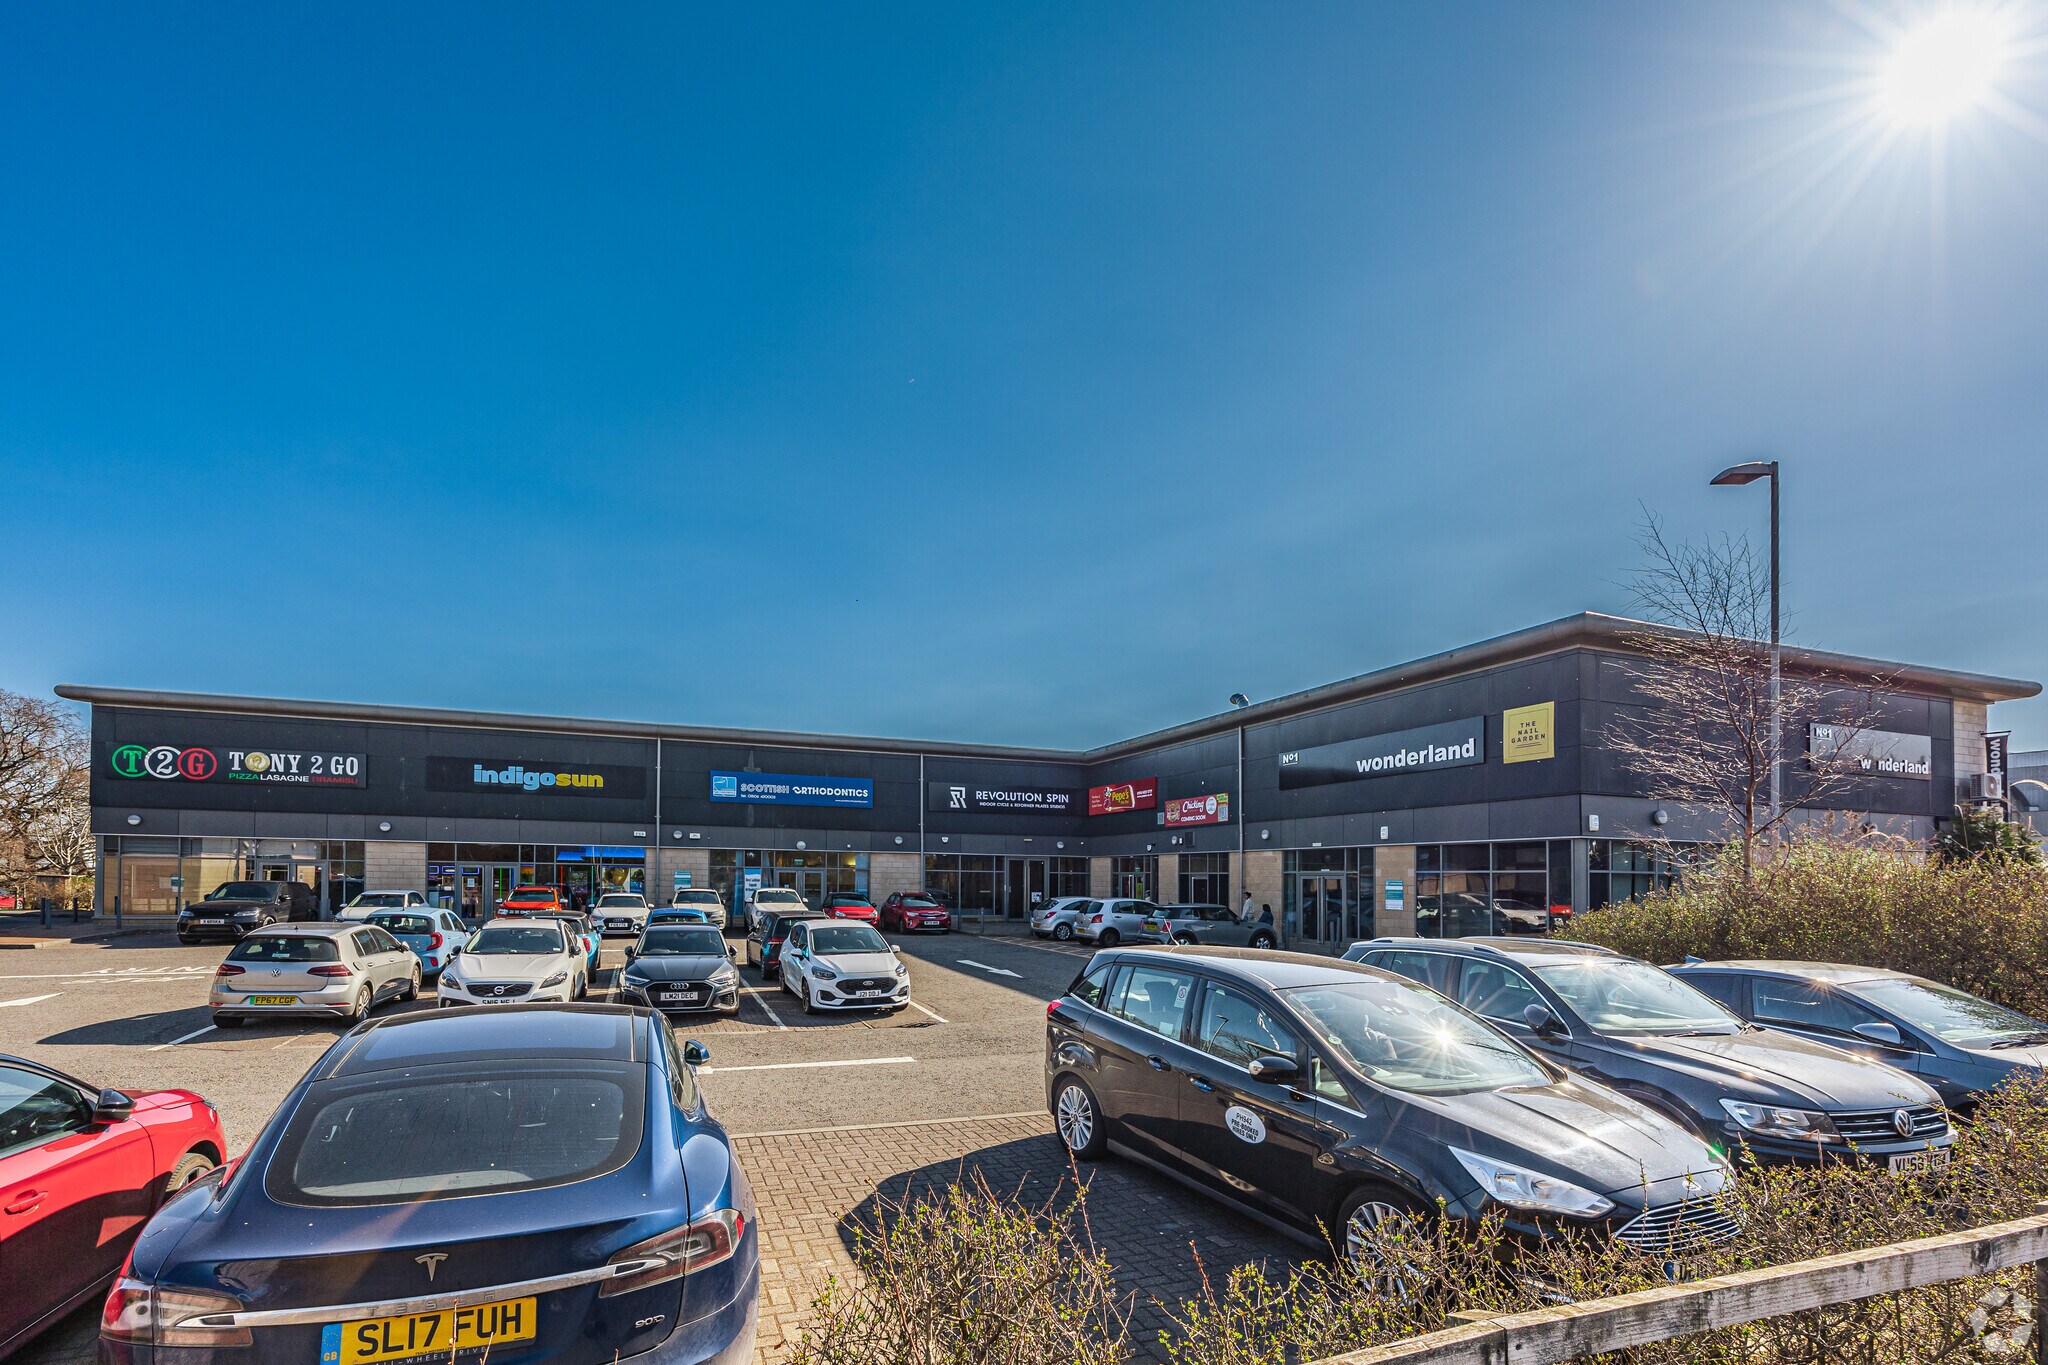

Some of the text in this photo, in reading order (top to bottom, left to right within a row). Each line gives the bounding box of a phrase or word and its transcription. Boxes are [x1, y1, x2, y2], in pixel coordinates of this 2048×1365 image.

[1520, 720, 1536, 728] THE
[1511, 733, 1546, 744] GARDEN
[1517, 728, 1539, 736] NAIL
[1356, 738, 1475, 773] wonderland
[310, 755, 324, 774] 2
[330, 756, 359, 776] GO
[1860, 758, 1929, 775] wnderland
[228, 772, 359, 784] PIZZA LASAGNE TIRAMISU
[474, 764, 603, 790] indigosun
[740, 783, 790, 794] SCOTTISH
[792, 786, 868, 798] ORTHODONTICS
[975, 790, 1042, 802] REVOLUTION
[1046, 793, 1069, 803] SPIN
[1111, 789, 1129, 803] Pepe's
[254, 995, 296, 1004] FP67 CGF
[366, 1292, 496, 1317] TESLA
[357, 1303, 521, 1357] SL17 FUH
[323, 1351, 338, 1362] GB
